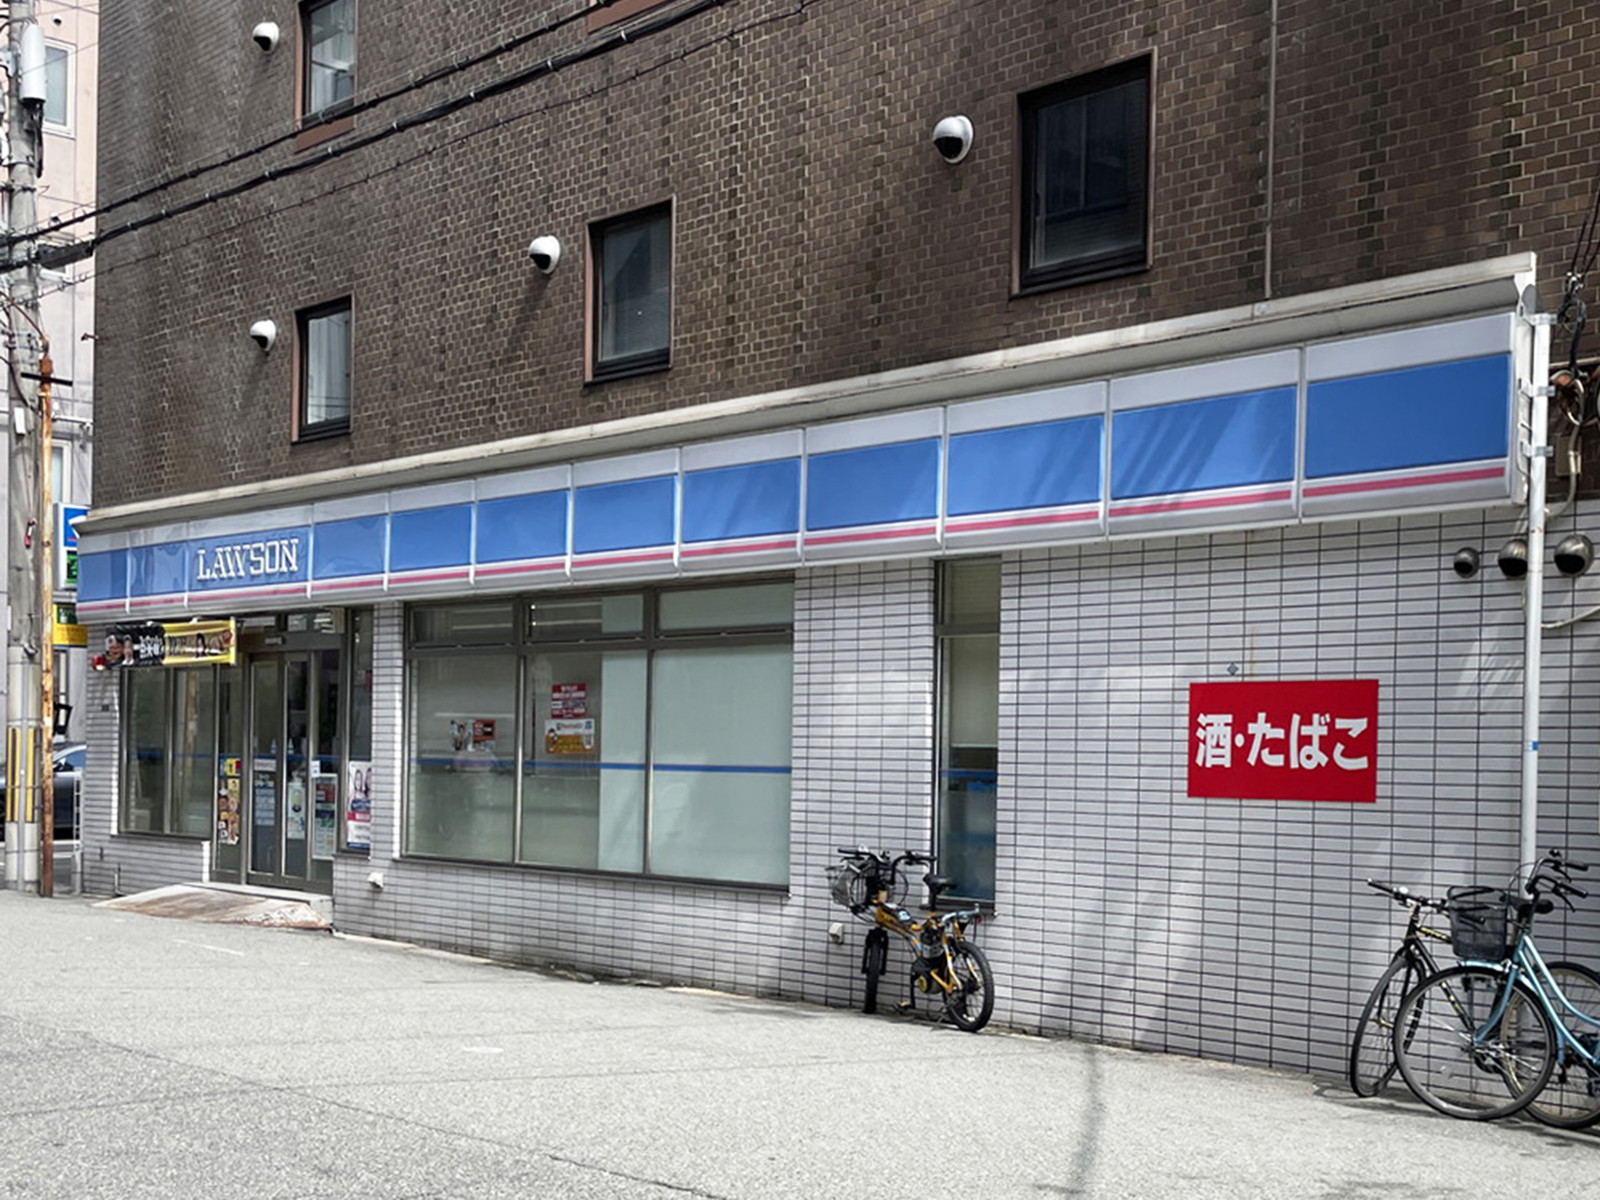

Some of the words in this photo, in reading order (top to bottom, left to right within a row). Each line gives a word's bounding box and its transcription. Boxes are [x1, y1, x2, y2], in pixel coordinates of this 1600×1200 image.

[196, 538, 299, 580] LAWSON
[1194, 712, 1369, 770] 酒・たばこ
